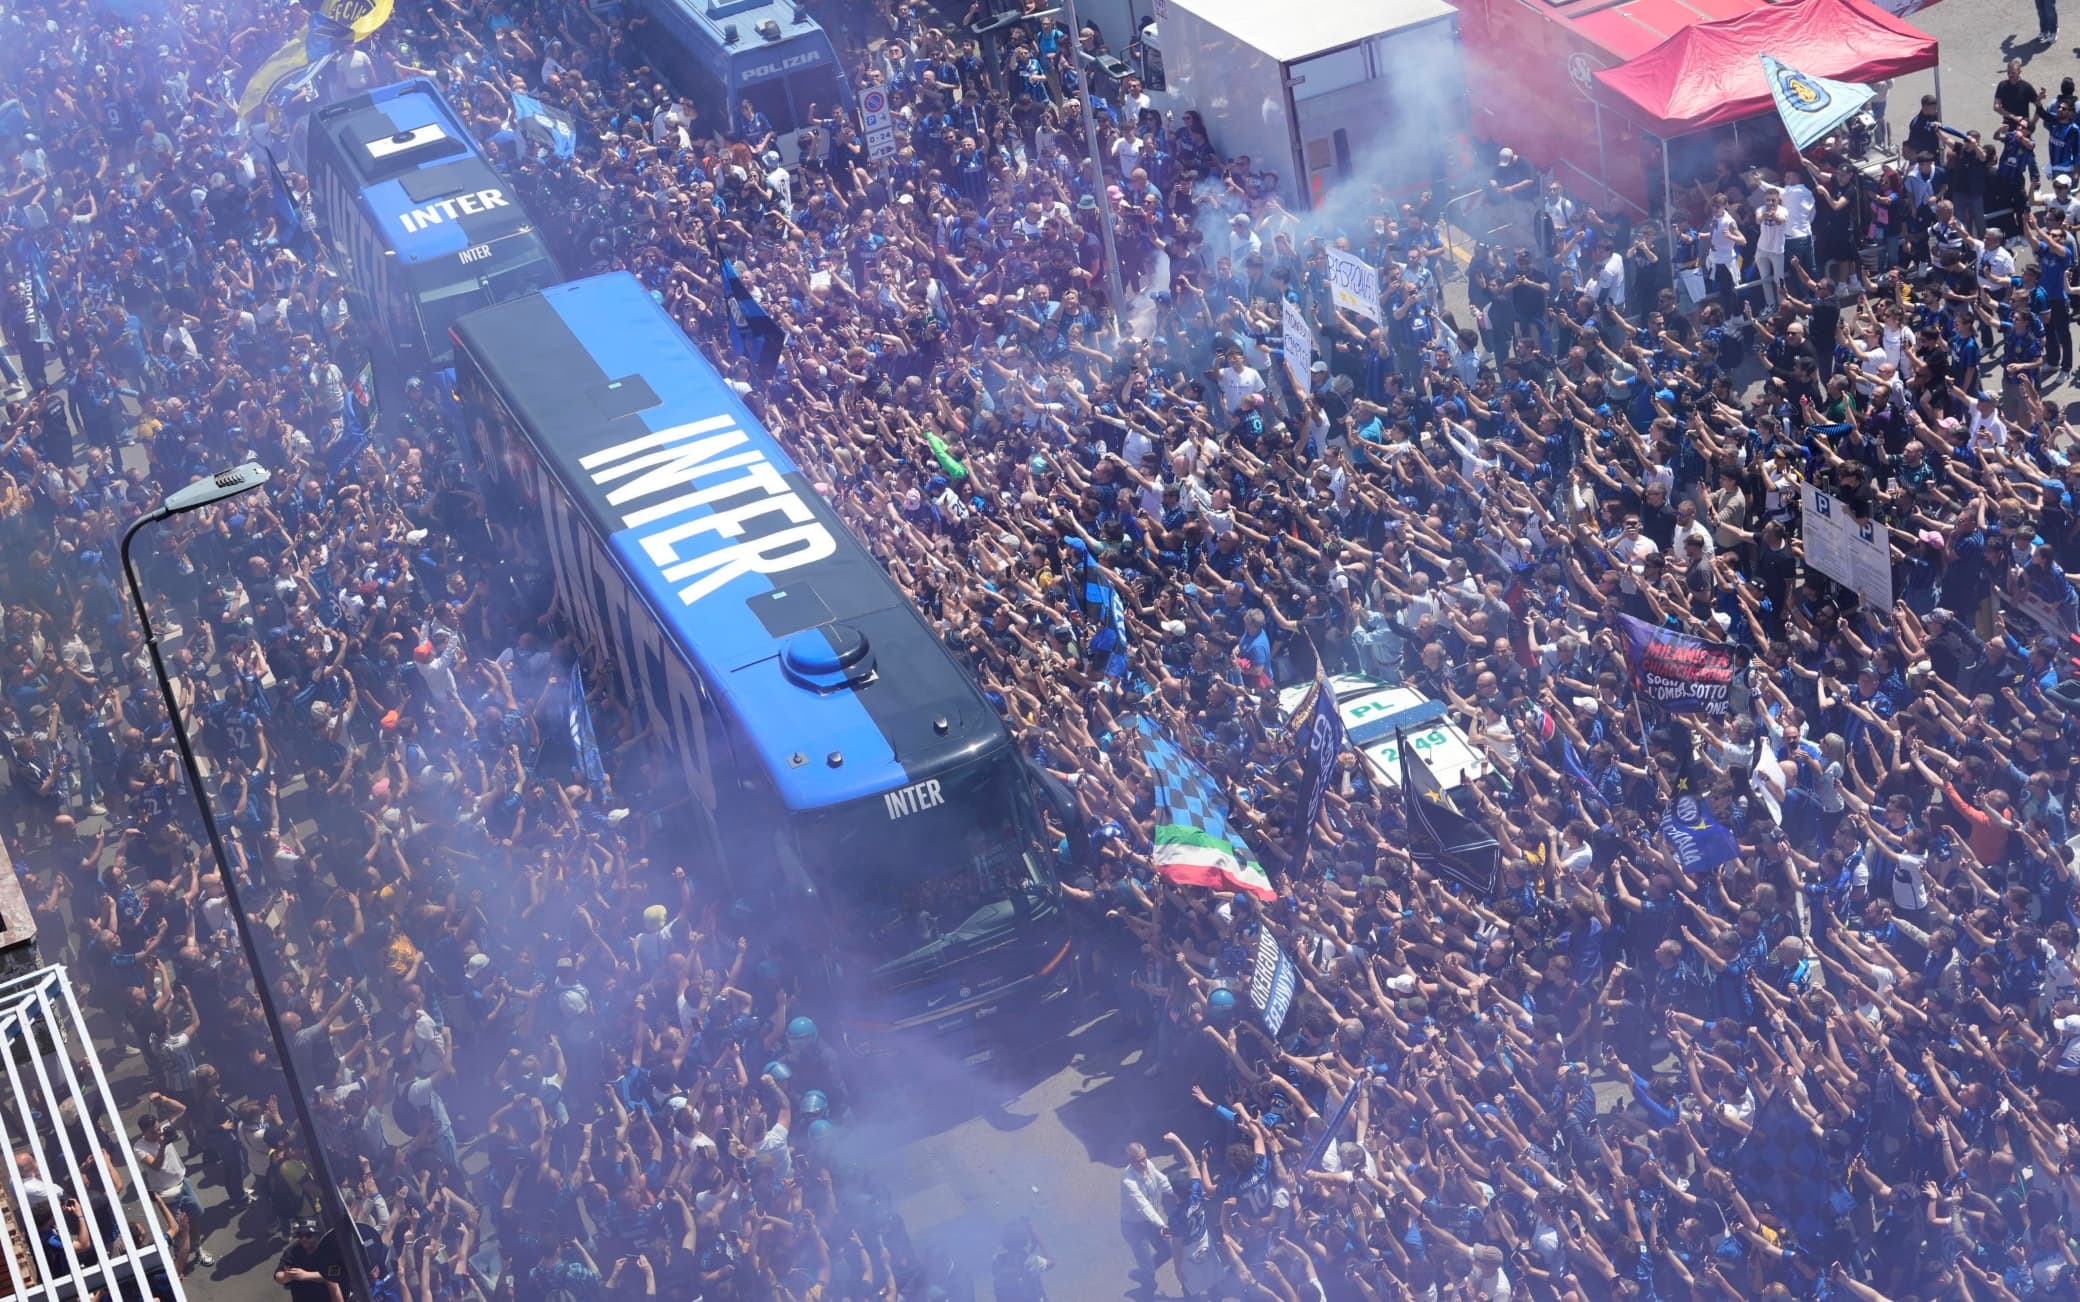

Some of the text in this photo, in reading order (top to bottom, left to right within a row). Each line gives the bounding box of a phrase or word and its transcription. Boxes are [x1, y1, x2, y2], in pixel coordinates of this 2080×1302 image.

[742, 50, 820, 80] POLIZIA
[399, 188, 510, 233] INTER
[457, 243, 493, 265] INTER
[578, 413, 837, 606] INTER
[1690, 684, 1728, 700] SOTTO
[1349, 701, 1394, 718] PL
[884, 780, 945, 820] INTER
